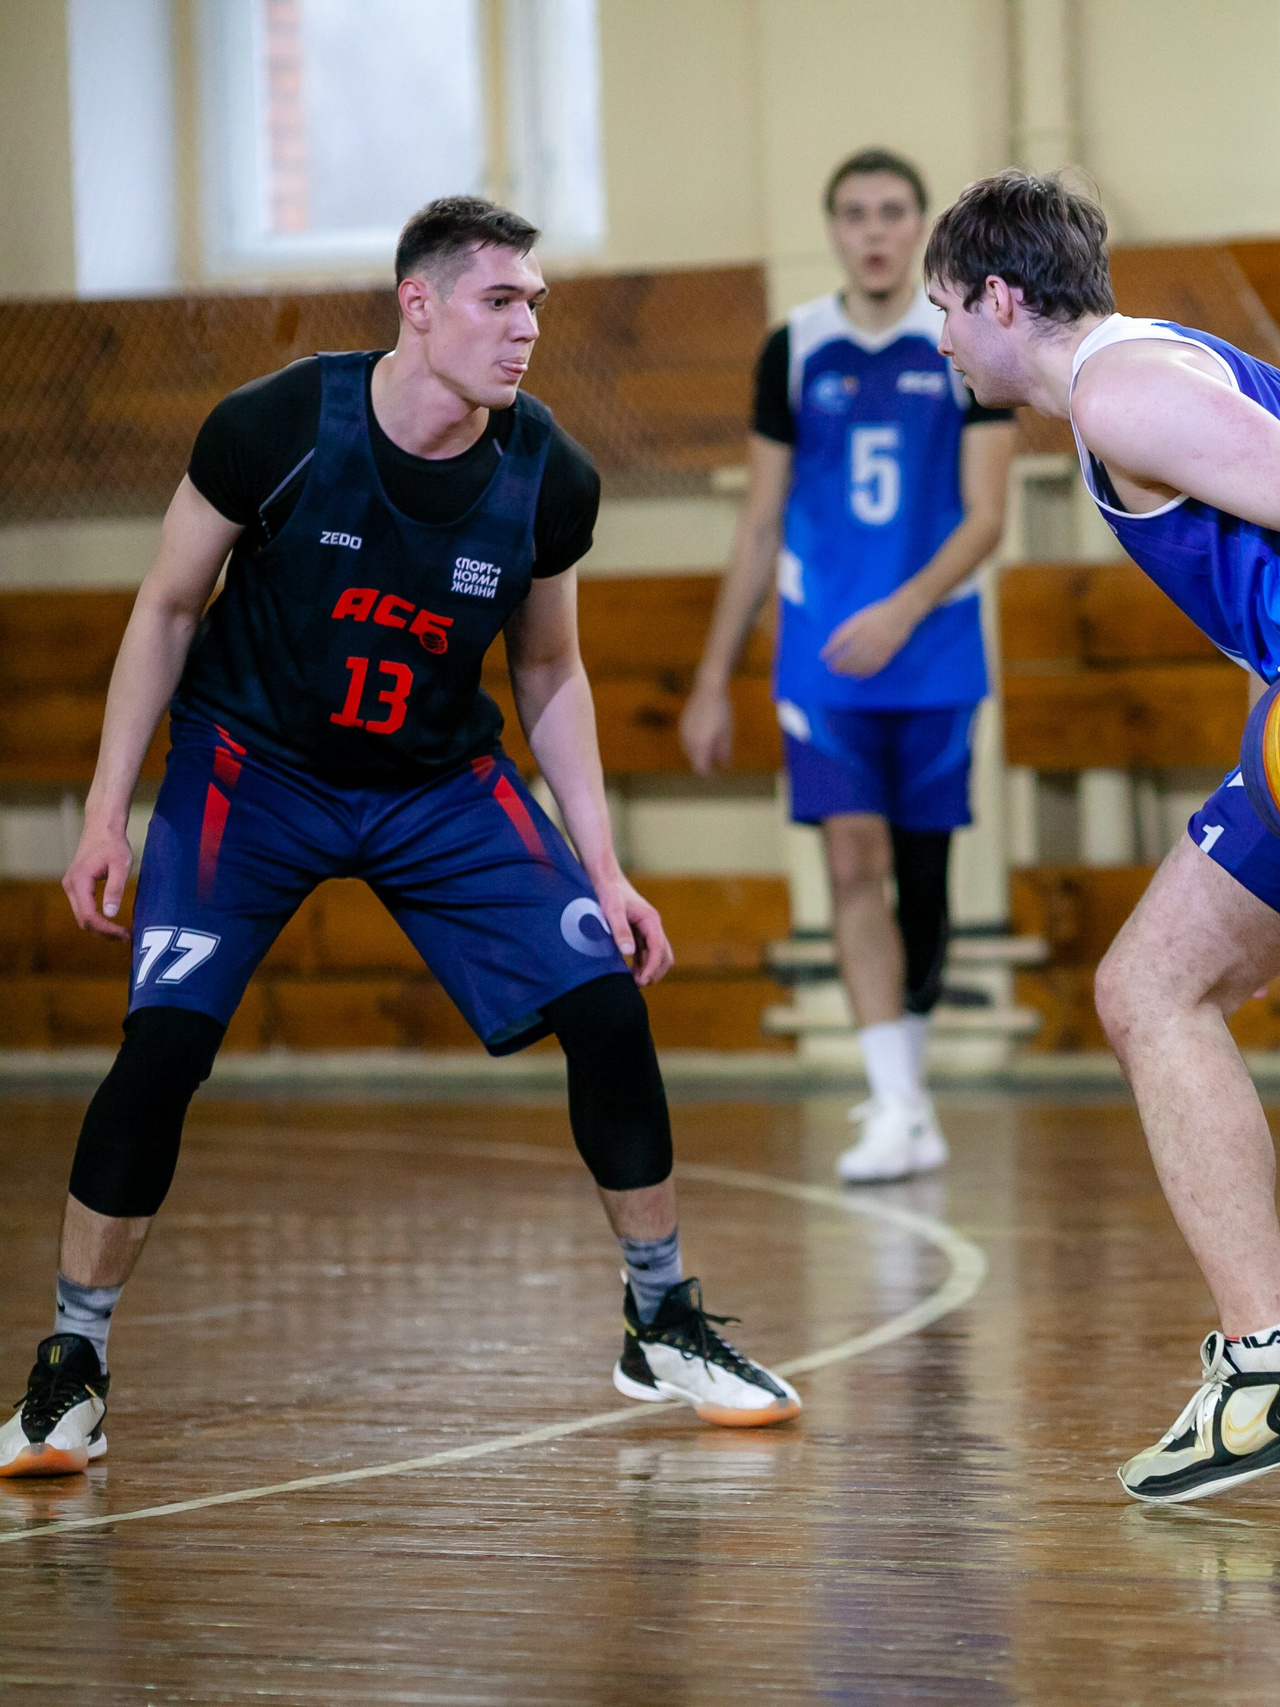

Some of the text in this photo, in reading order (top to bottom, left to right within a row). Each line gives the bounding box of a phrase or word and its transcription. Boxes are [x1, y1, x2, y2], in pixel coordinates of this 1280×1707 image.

[850, 424, 901, 526] 5
[320, 531, 362, 550] ZEDO
[451, 580, 496, 599] ЖИЗНИ
[453, 568, 499, 587] НОРМА
[330, 656, 413, 735] 13
[1199, 824, 1225, 854] 1
[135, 926, 221, 990] 77
